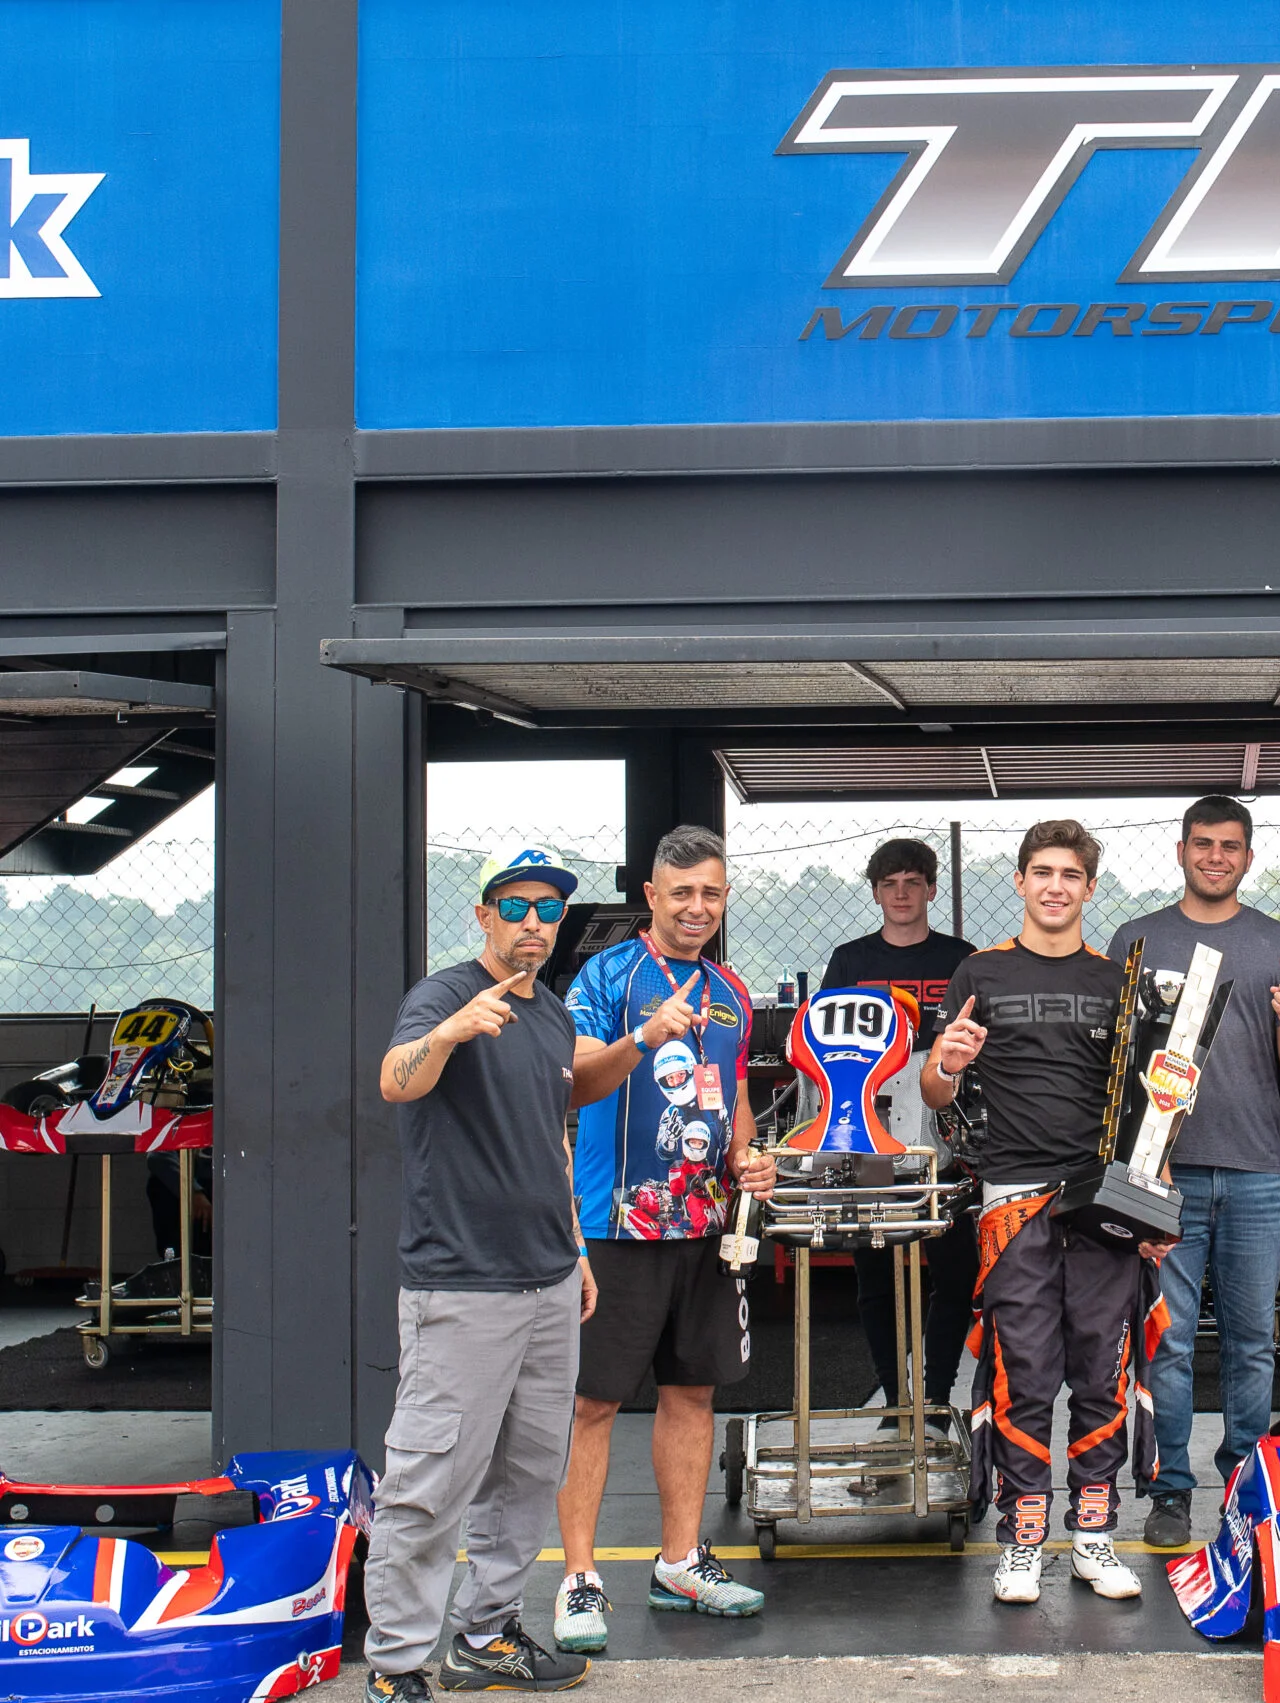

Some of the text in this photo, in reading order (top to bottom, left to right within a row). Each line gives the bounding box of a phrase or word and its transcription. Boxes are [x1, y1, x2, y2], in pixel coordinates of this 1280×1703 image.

[118, 1015, 168, 1042] 44
[818, 1002, 883, 1038] 119
[1015, 1494, 1047, 1545] CRG
[18, 1645, 95, 1656] ESTACIONAMENTOS
